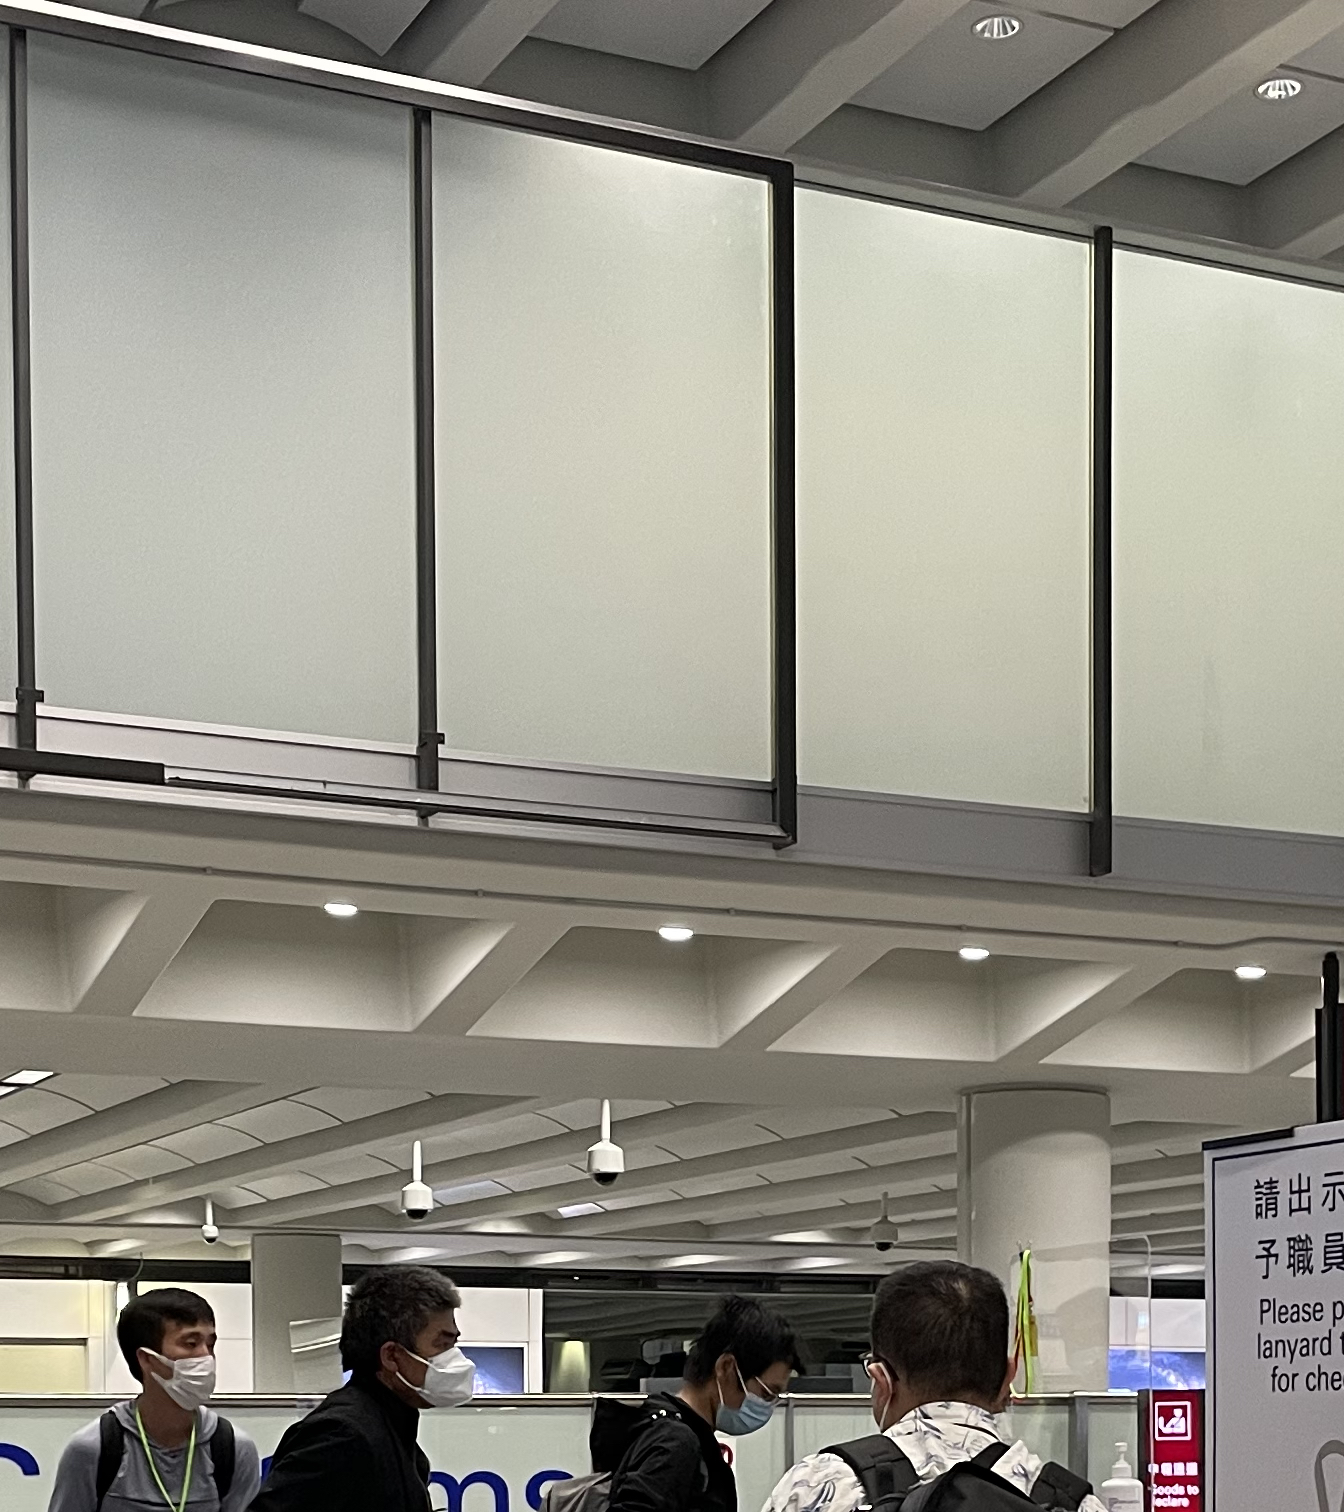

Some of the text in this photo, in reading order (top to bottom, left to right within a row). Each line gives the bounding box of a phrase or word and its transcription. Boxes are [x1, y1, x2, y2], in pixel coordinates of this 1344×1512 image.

[1260, 1298, 1324, 1324] Please
[1257, 1329, 1332, 1364] lanyard
[1271, 1365, 1299, 1392] for
[1187, 1485, 1200, 1496] to
